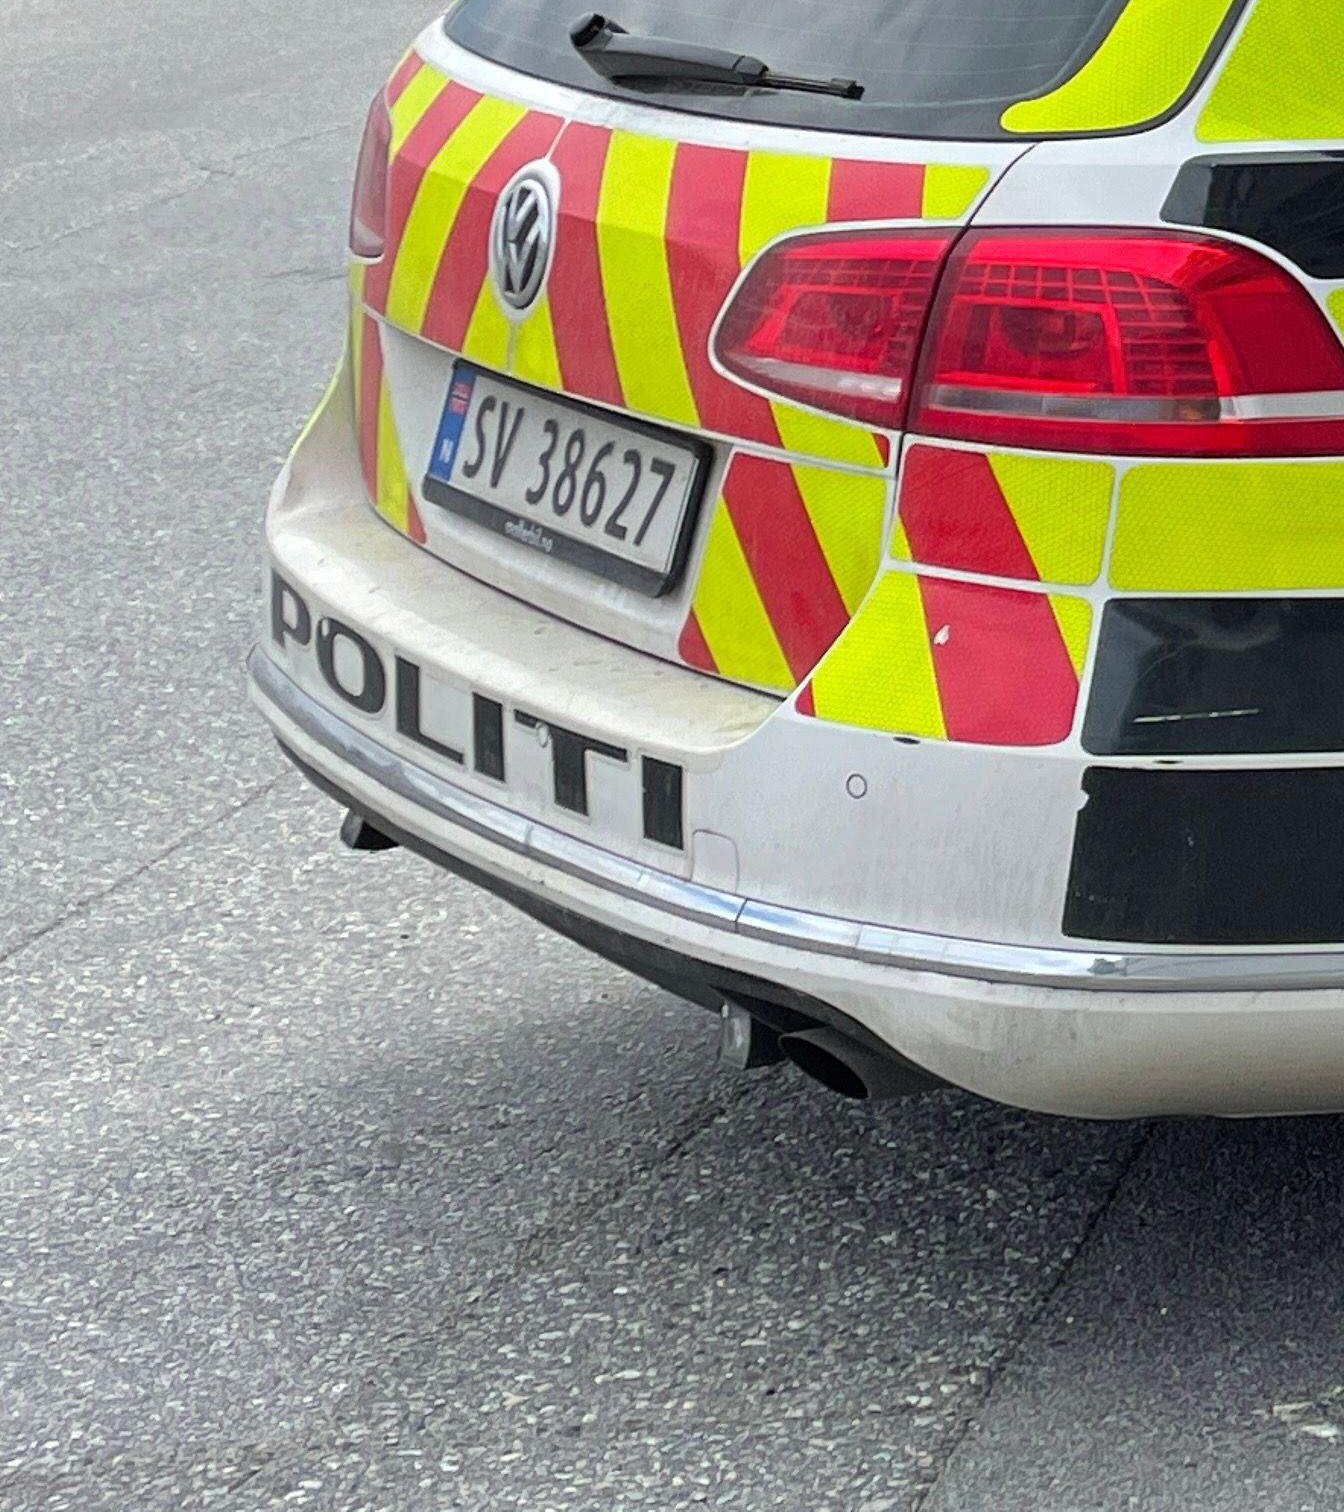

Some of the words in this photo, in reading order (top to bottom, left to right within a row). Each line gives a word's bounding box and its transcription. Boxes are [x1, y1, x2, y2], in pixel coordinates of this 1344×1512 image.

[438, 438, 455, 465] N
[461, 394, 526, 490] SV
[525, 418, 677, 548] 38627
[270, 568, 685, 851] POLITI
